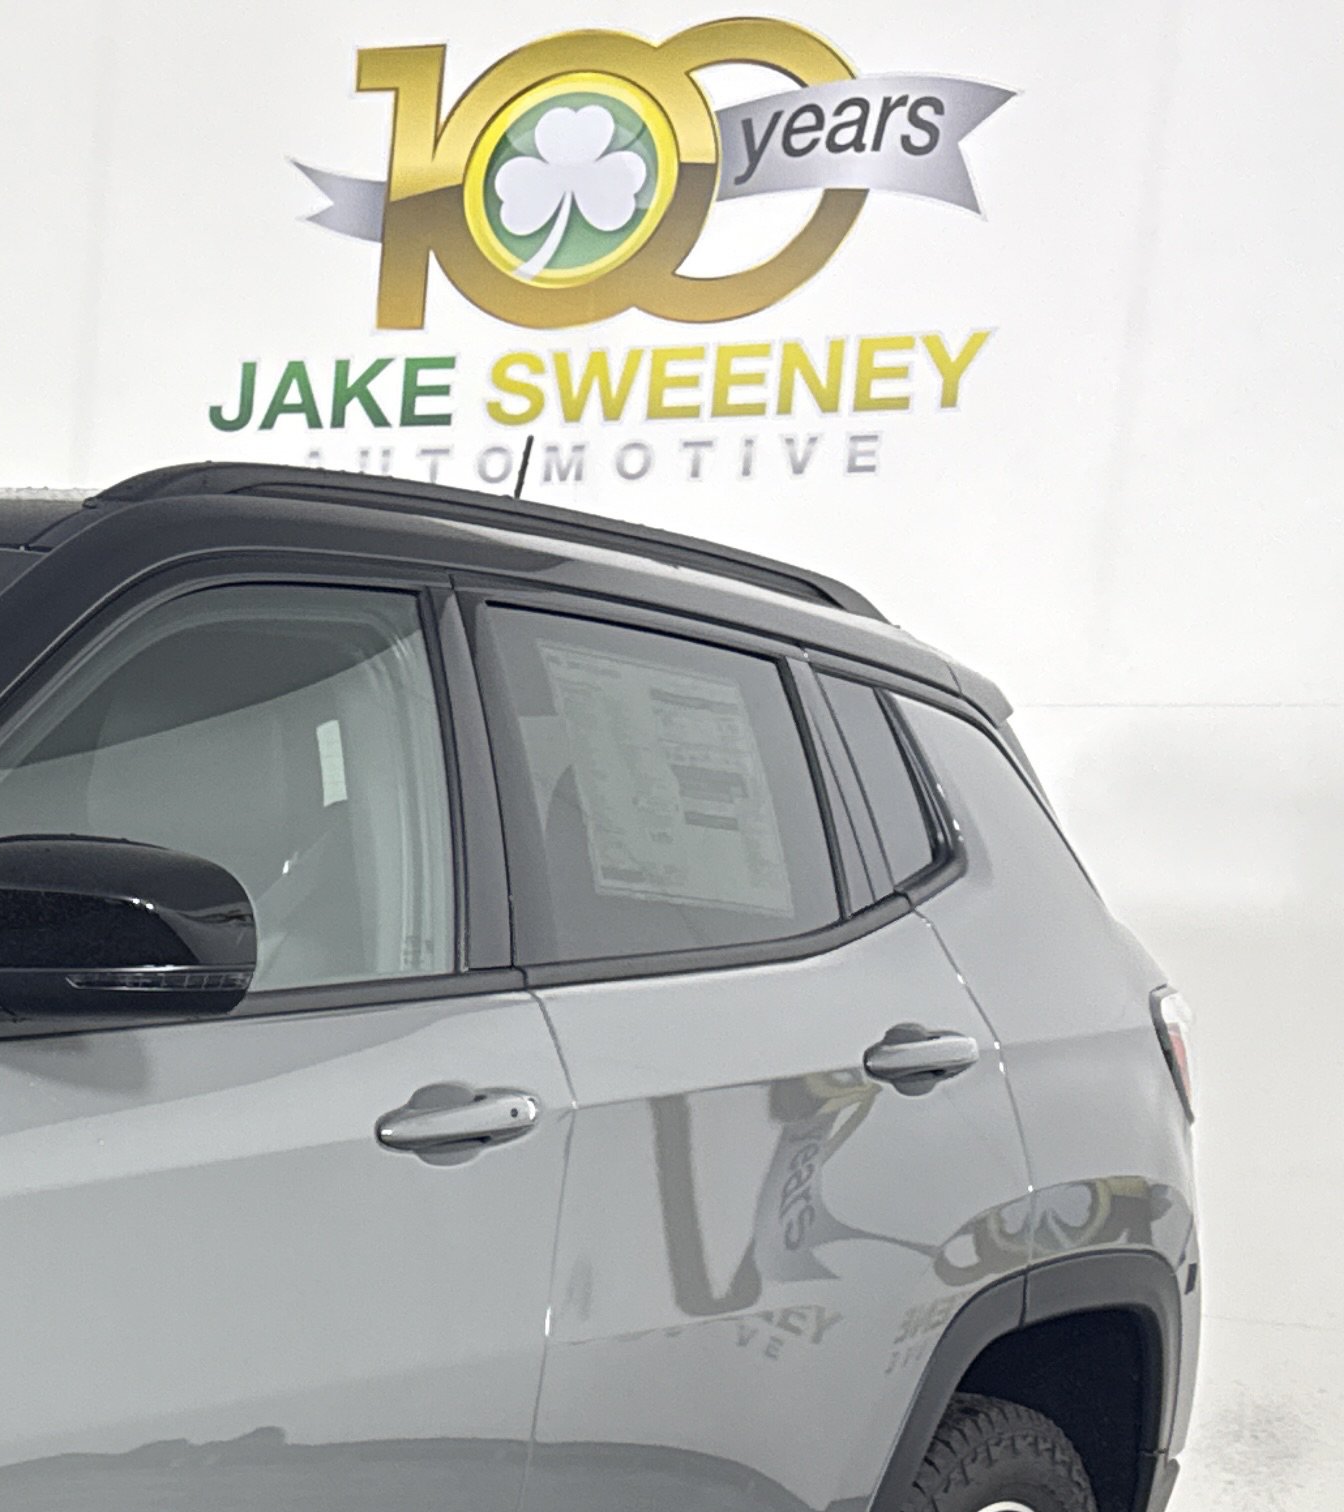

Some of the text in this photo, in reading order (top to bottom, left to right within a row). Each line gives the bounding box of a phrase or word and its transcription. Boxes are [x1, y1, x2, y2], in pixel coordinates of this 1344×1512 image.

[355, 16, 869, 331] 100
[733, 91, 945, 185] years
[209, 331, 992, 432] JAKE SWEENEY
